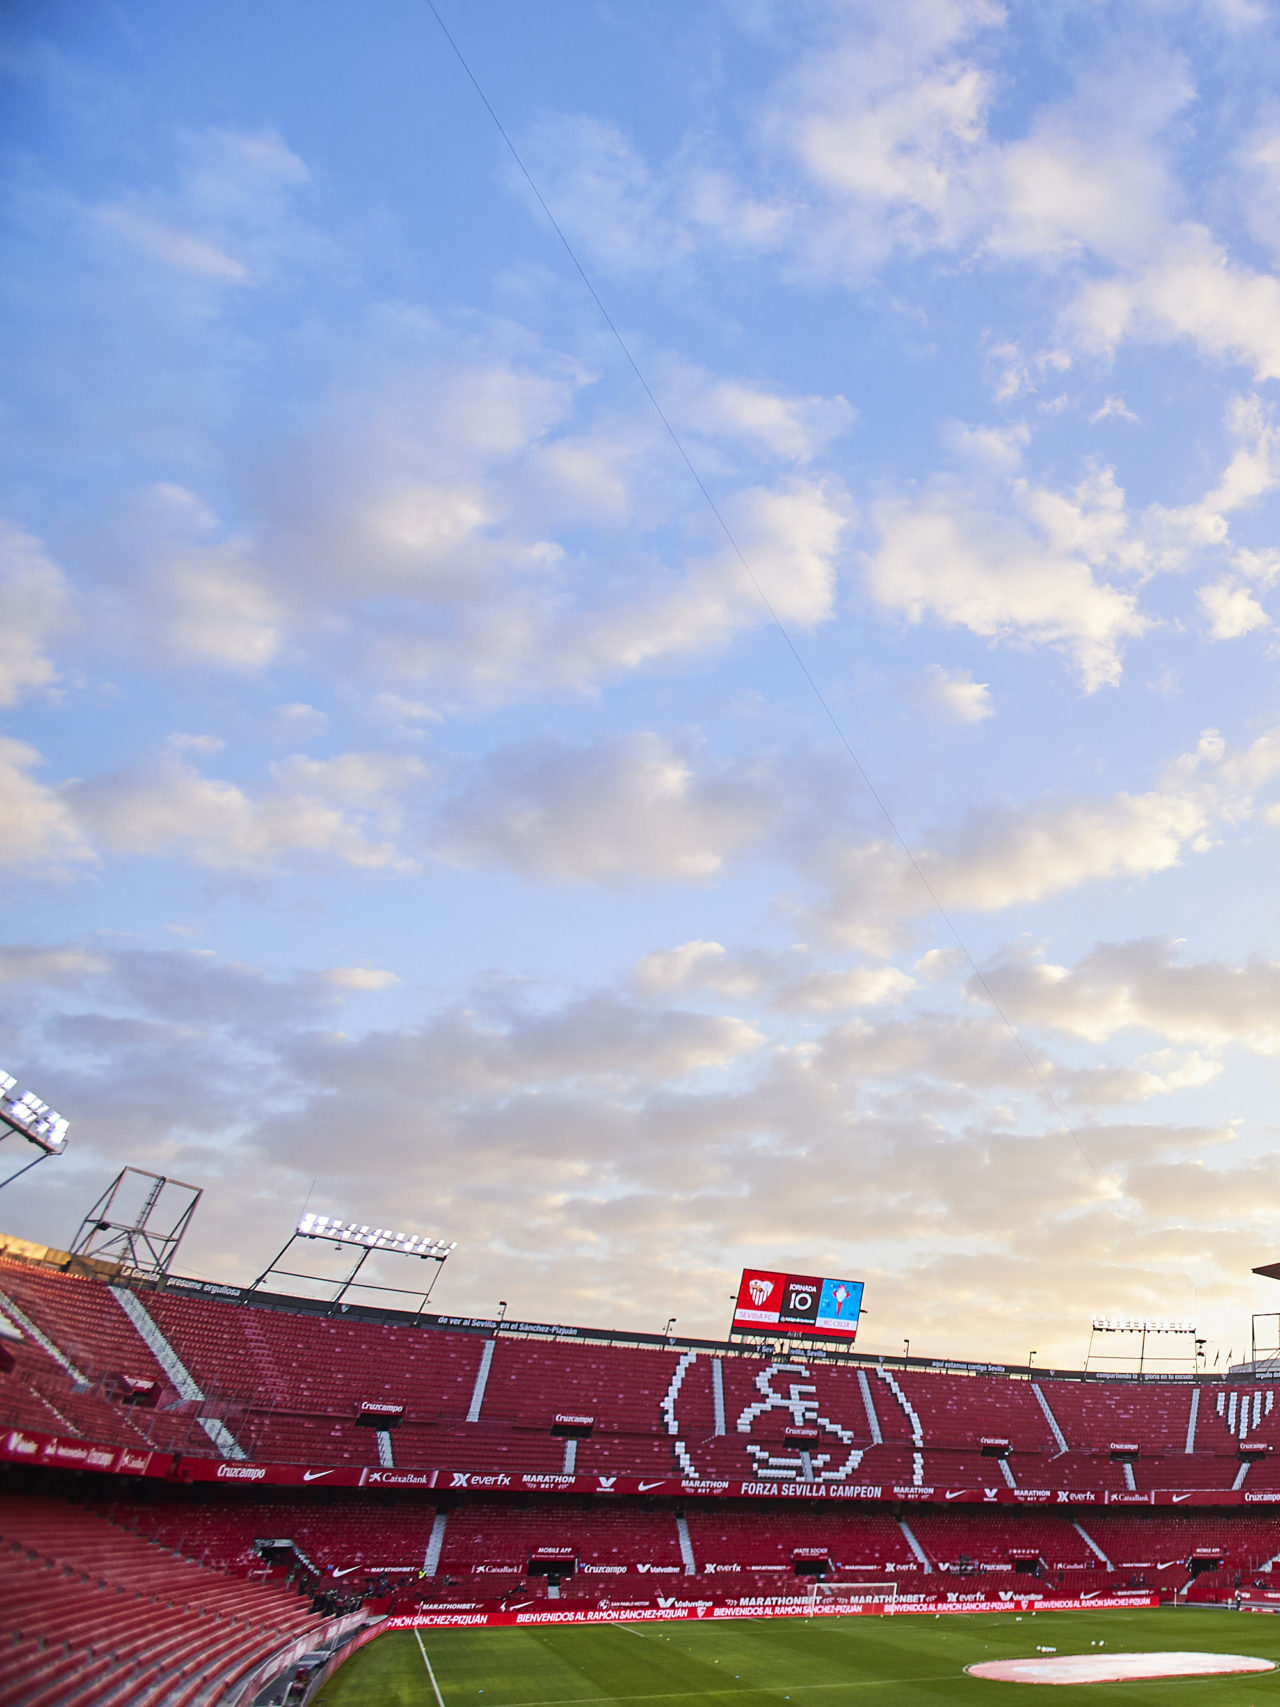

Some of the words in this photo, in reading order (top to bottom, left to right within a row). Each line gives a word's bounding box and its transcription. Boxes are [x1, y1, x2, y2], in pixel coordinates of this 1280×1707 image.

[166, 1277, 202, 1290] presume
[203, 1283, 240, 1296] orgullosa
[789, 1283, 817, 1293] JORNADA
[438, 1316, 447, 1324] de
[450, 1318, 462, 1326] ver
[510, 1322, 518, 1330] el
[988, 1364, 1006, 1372] Sevilla
[361, 1401, 404, 1413] Cruzcampo
[555, 1414, 594, 1424] Cruzcampo
[785, 1427, 818, 1436] Cruzcampo
[1110, 1442, 1139, 1450] Cruzcampo
[217, 1464, 266, 1480] Cruzcampo
[382, 1473, 428, 1484] CaixaBank
[471, 1473, 511, 1486] everfx
[522, 1475, 576, 1484] MARATHON
[681, 1480, 729, 1488] MARATHON
[741, 1482, 778, 1495] FORZA
[781, 1483, 827, 1497] SEVILLA
[830, 1484, 882, 1498] CAMPEON
[1069, 1491, 1095, 1501] everfx
[1118, 1494, 1149, 1502] CaixaBank
[1245, 1492, 1280, 1502] Cruzcampo
[485, 1565, 518, 1573] CaixaBank
[584, 1564, 628, 1574] Cruzcampo
[716, 1564, 741, 1572] everfx
[896, 1563, 917, 1571] everfx
[740, 1595, 822, 1606] MARATHONBET
[850, 1594, 926, 1604] MARATHONBET
[959, 1592, 985, 1601] everfx
[674, 1600, 713, 1608] Valvoline
[884, 1602, 928, 1612] BIENVENIDOS
[928, 1602, 936, 1611] AL
[937, 1600, 961, 1610] RAMÓN
[1034, 1600, 1073, 1609] BIENVENIDOS
[1073, 1599, 1081, 1608] AL
[1081, 1598, 1103, 1607] RAMÓN
[713, 1606, 763, 1616] BIENVENIDOS
[764, 1606, 773, 1615] AL
[774, 1604, 802, 1615] RAMÓN
[517, 1611, 574, 1623] BIENVENIDOS
[575, 1611, 585, 1621] AL
[587, 1609, 618, 1620] RAMÓN
